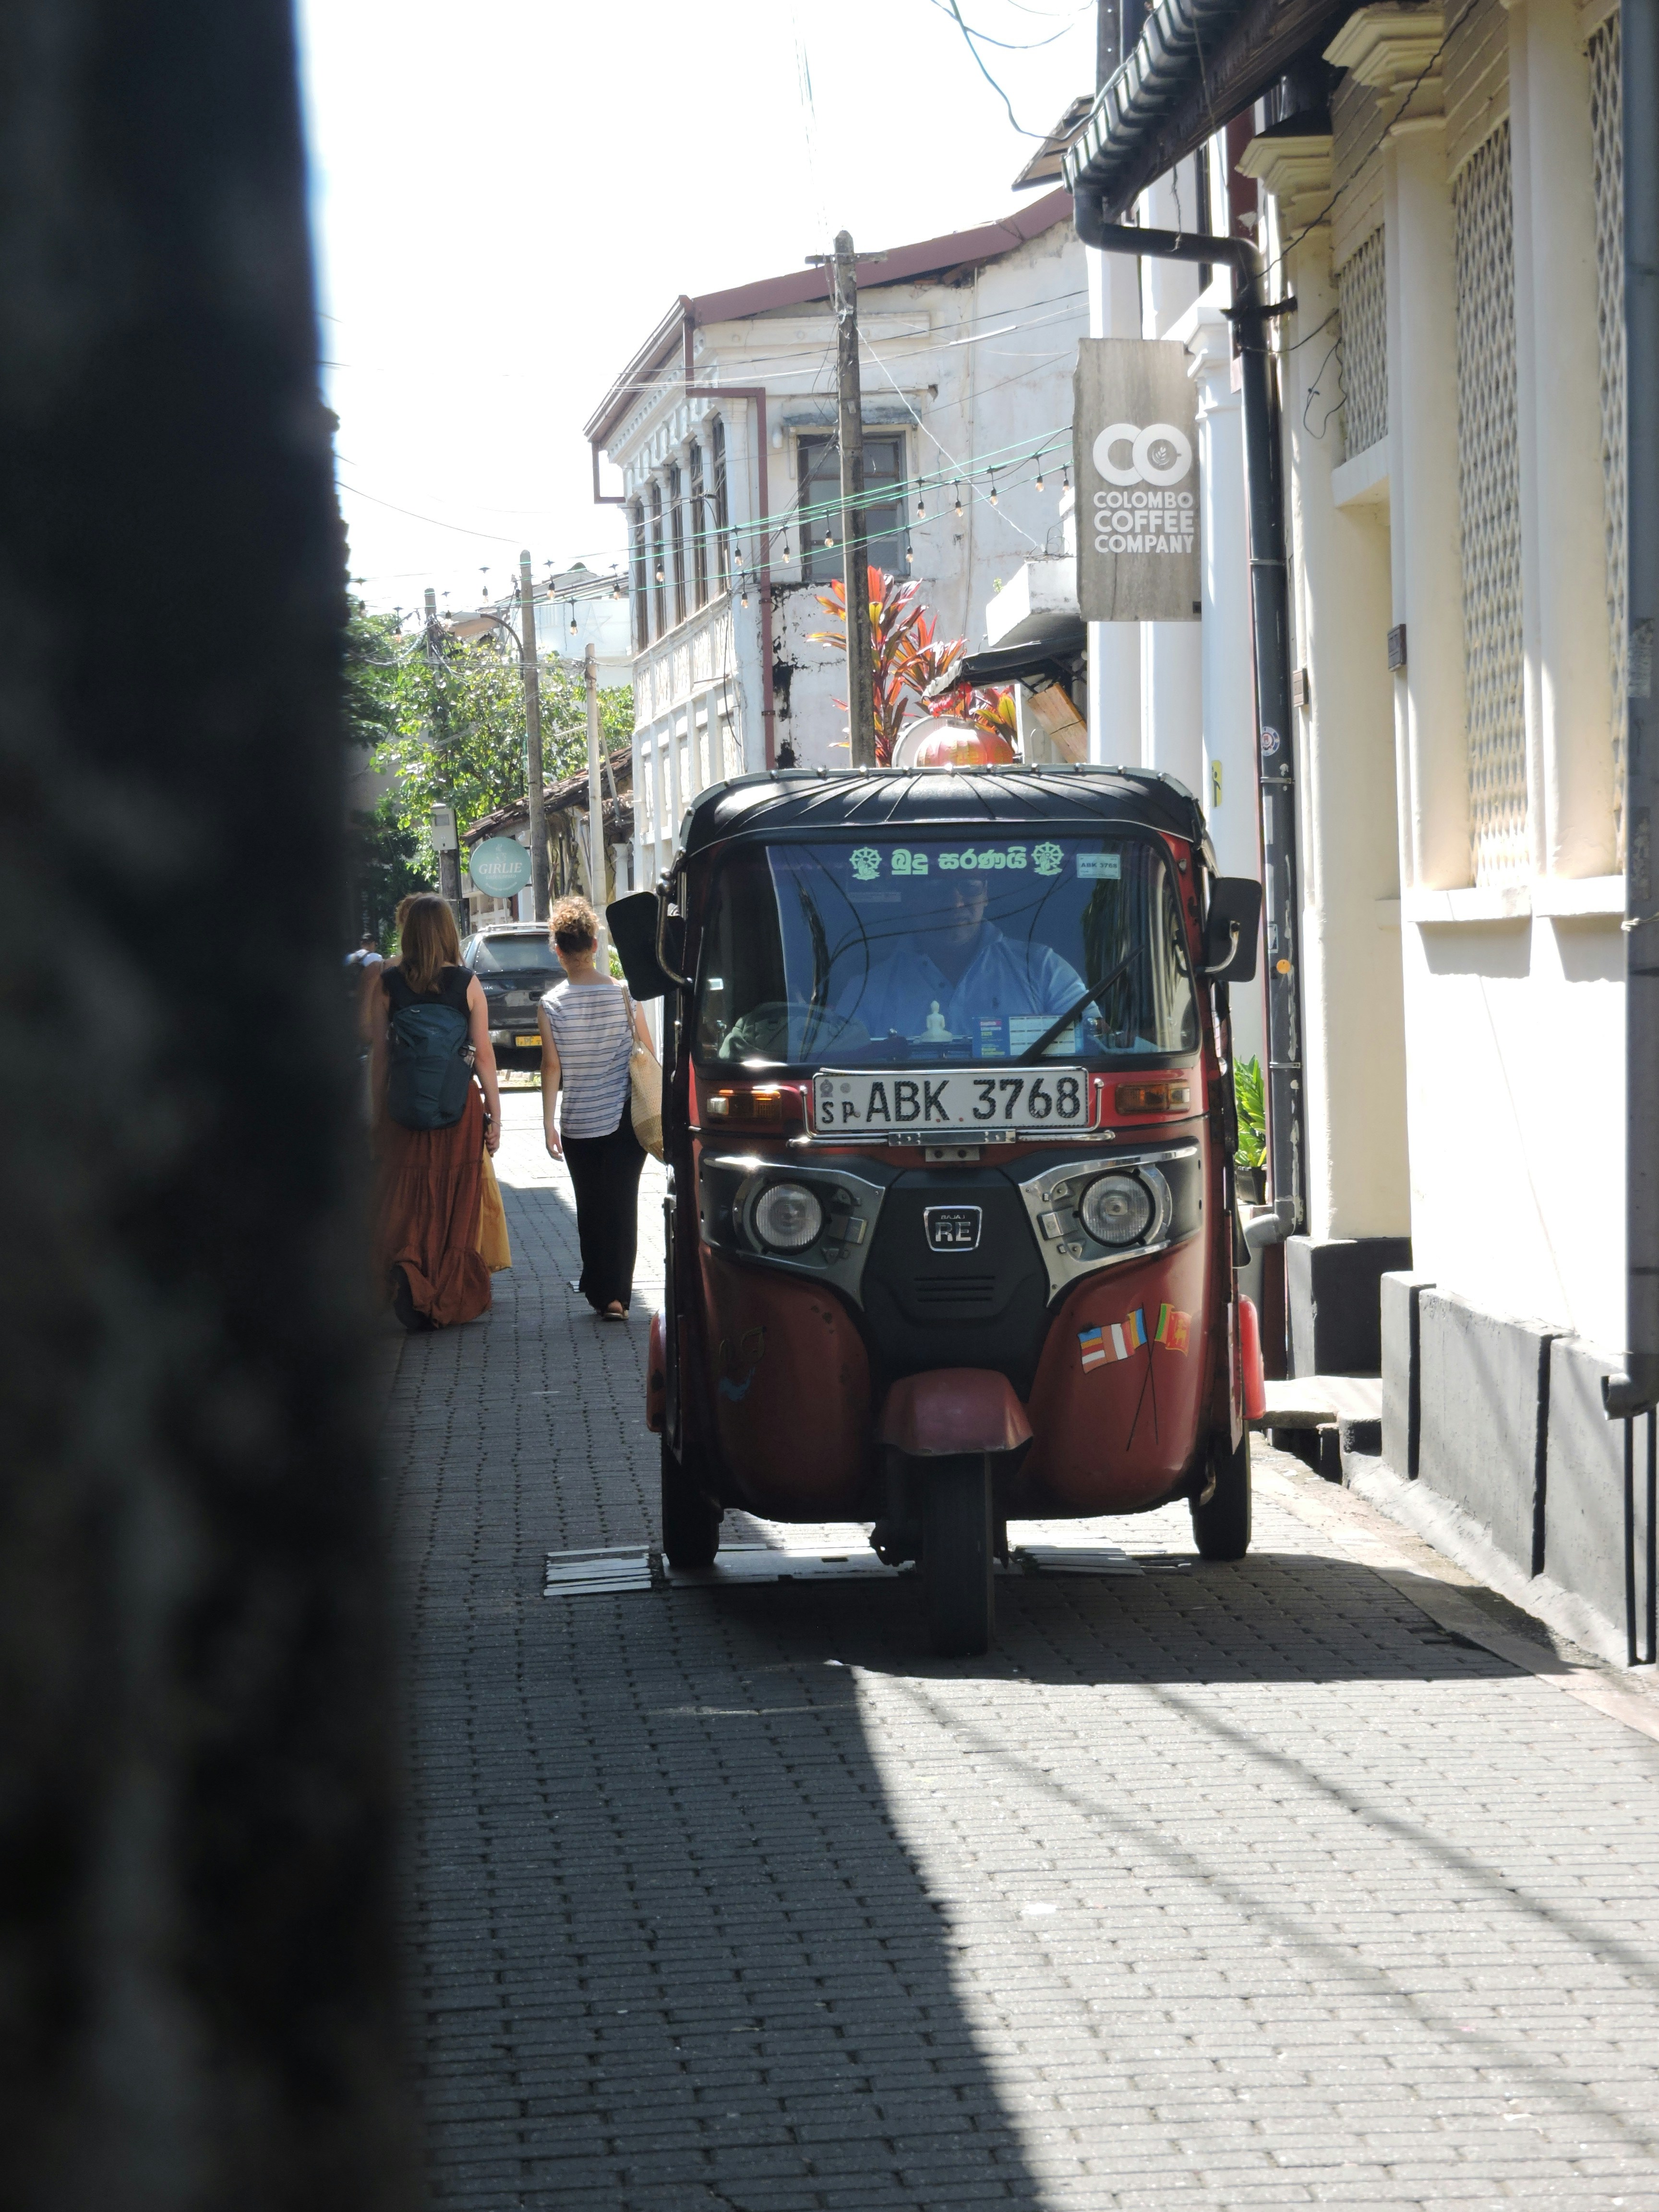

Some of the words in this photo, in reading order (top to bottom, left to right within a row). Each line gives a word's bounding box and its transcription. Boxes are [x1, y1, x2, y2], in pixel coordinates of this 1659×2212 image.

[1093, 491, 1193, 508] COLOMBO
[1094, 510, 1194, 533] COFFEE
[1094, 534, 1194, 553] COMPANY
[479, 862, 523, 874] GIRLIE
[891, 848, 928, 875] බුදු
[938, 846, 1027, 869] සරණයි
[866, 1080, 950, 1123] ABK
[972, 1077, 1081, 1120] 3768
[935, 1221, 972, 1242] RE
